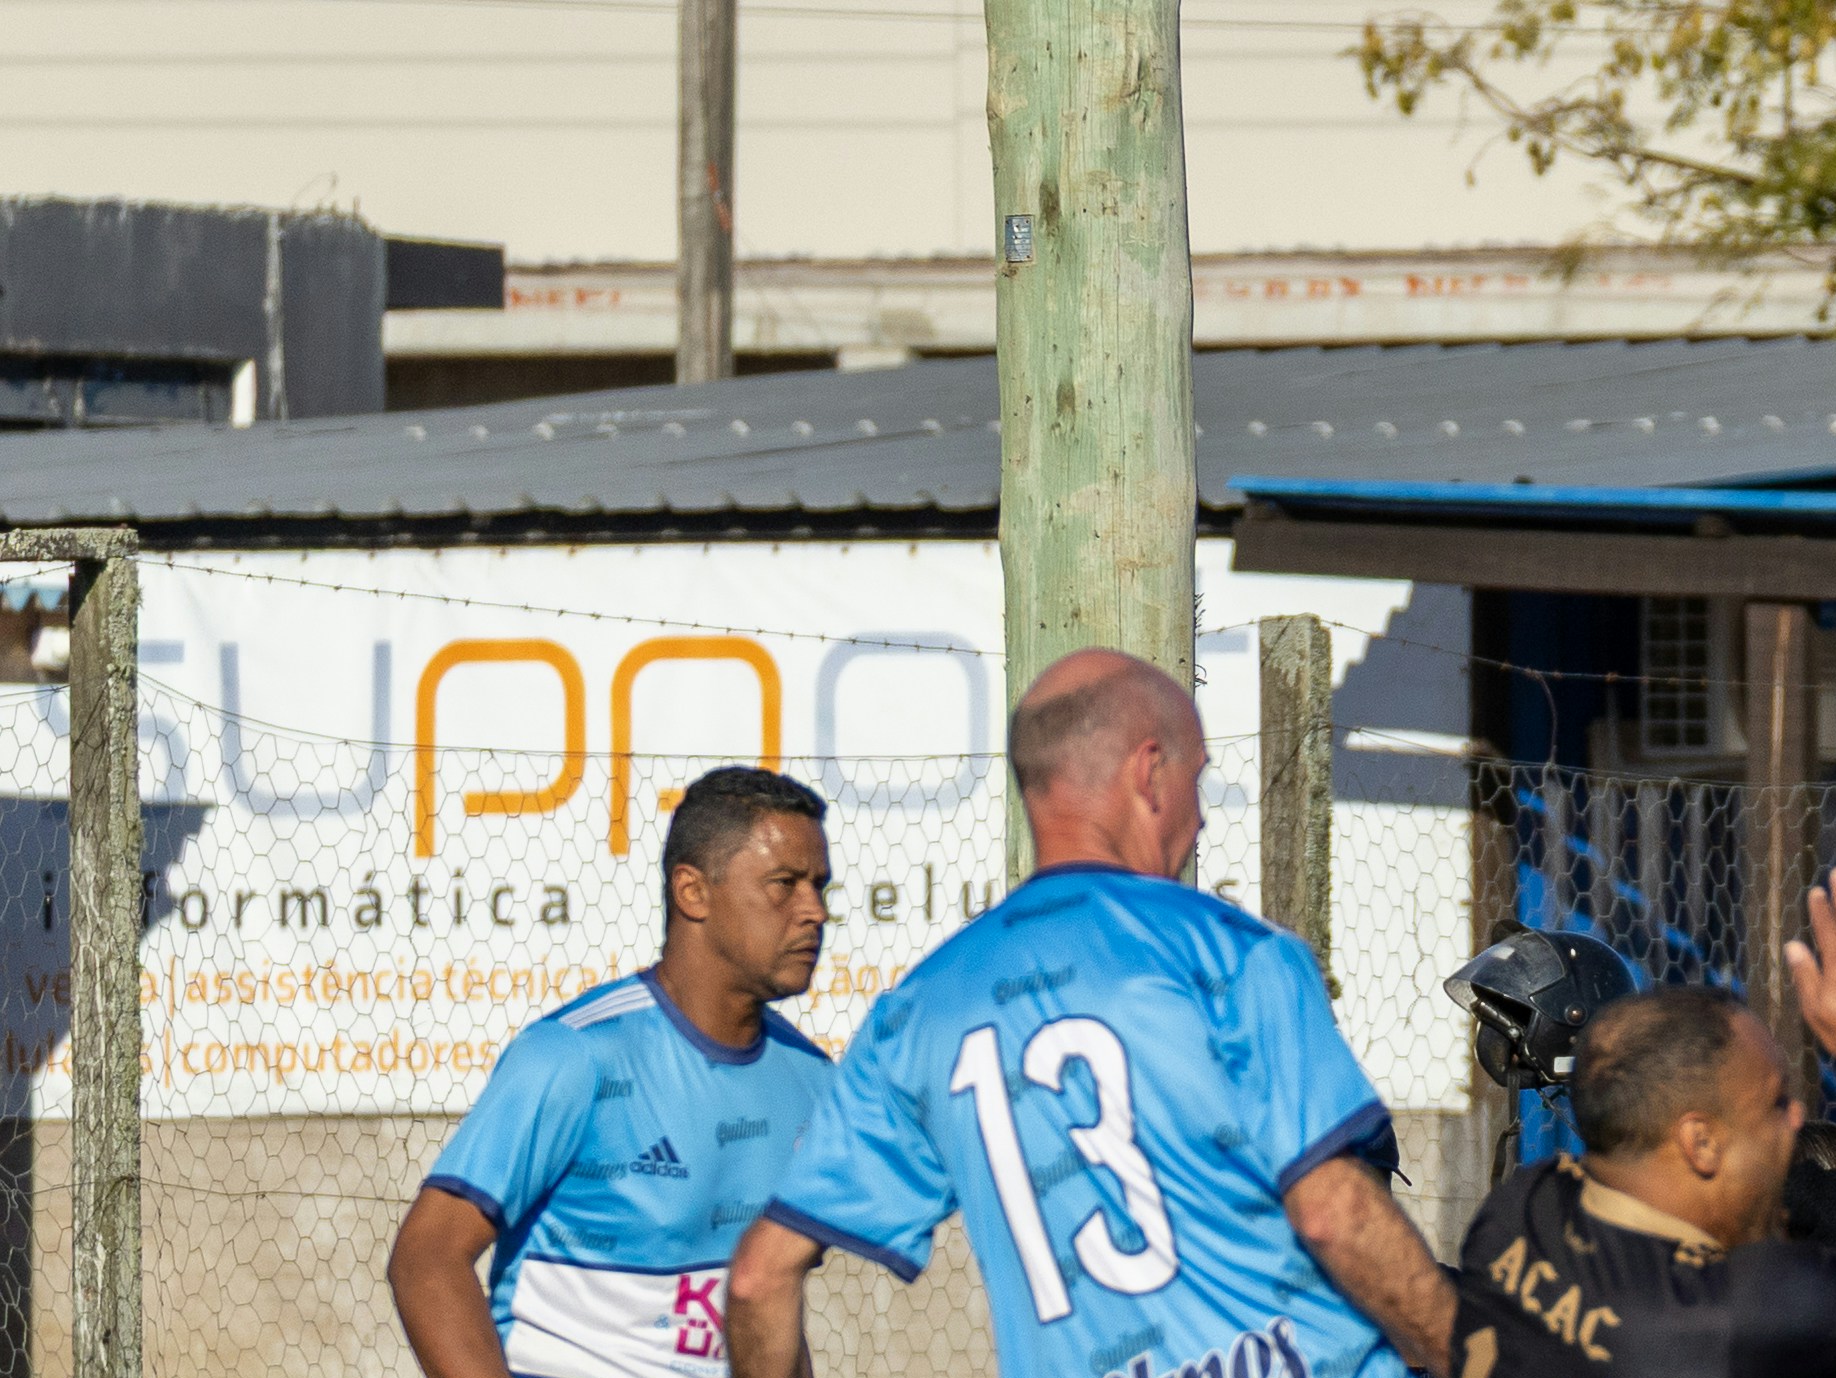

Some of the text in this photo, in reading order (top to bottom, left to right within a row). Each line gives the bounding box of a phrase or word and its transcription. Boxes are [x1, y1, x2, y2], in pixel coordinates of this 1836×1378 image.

[43, 866, 572, 930] iformática
[187, 956, 433, 1003] assistência
[182, 1026, 497, 1085] computadores
[629, 1160, 690, 1180] adidas
[949, 1015, 1180, 1324] 13
[1490, 1236, 1622, 1361] ACAC
